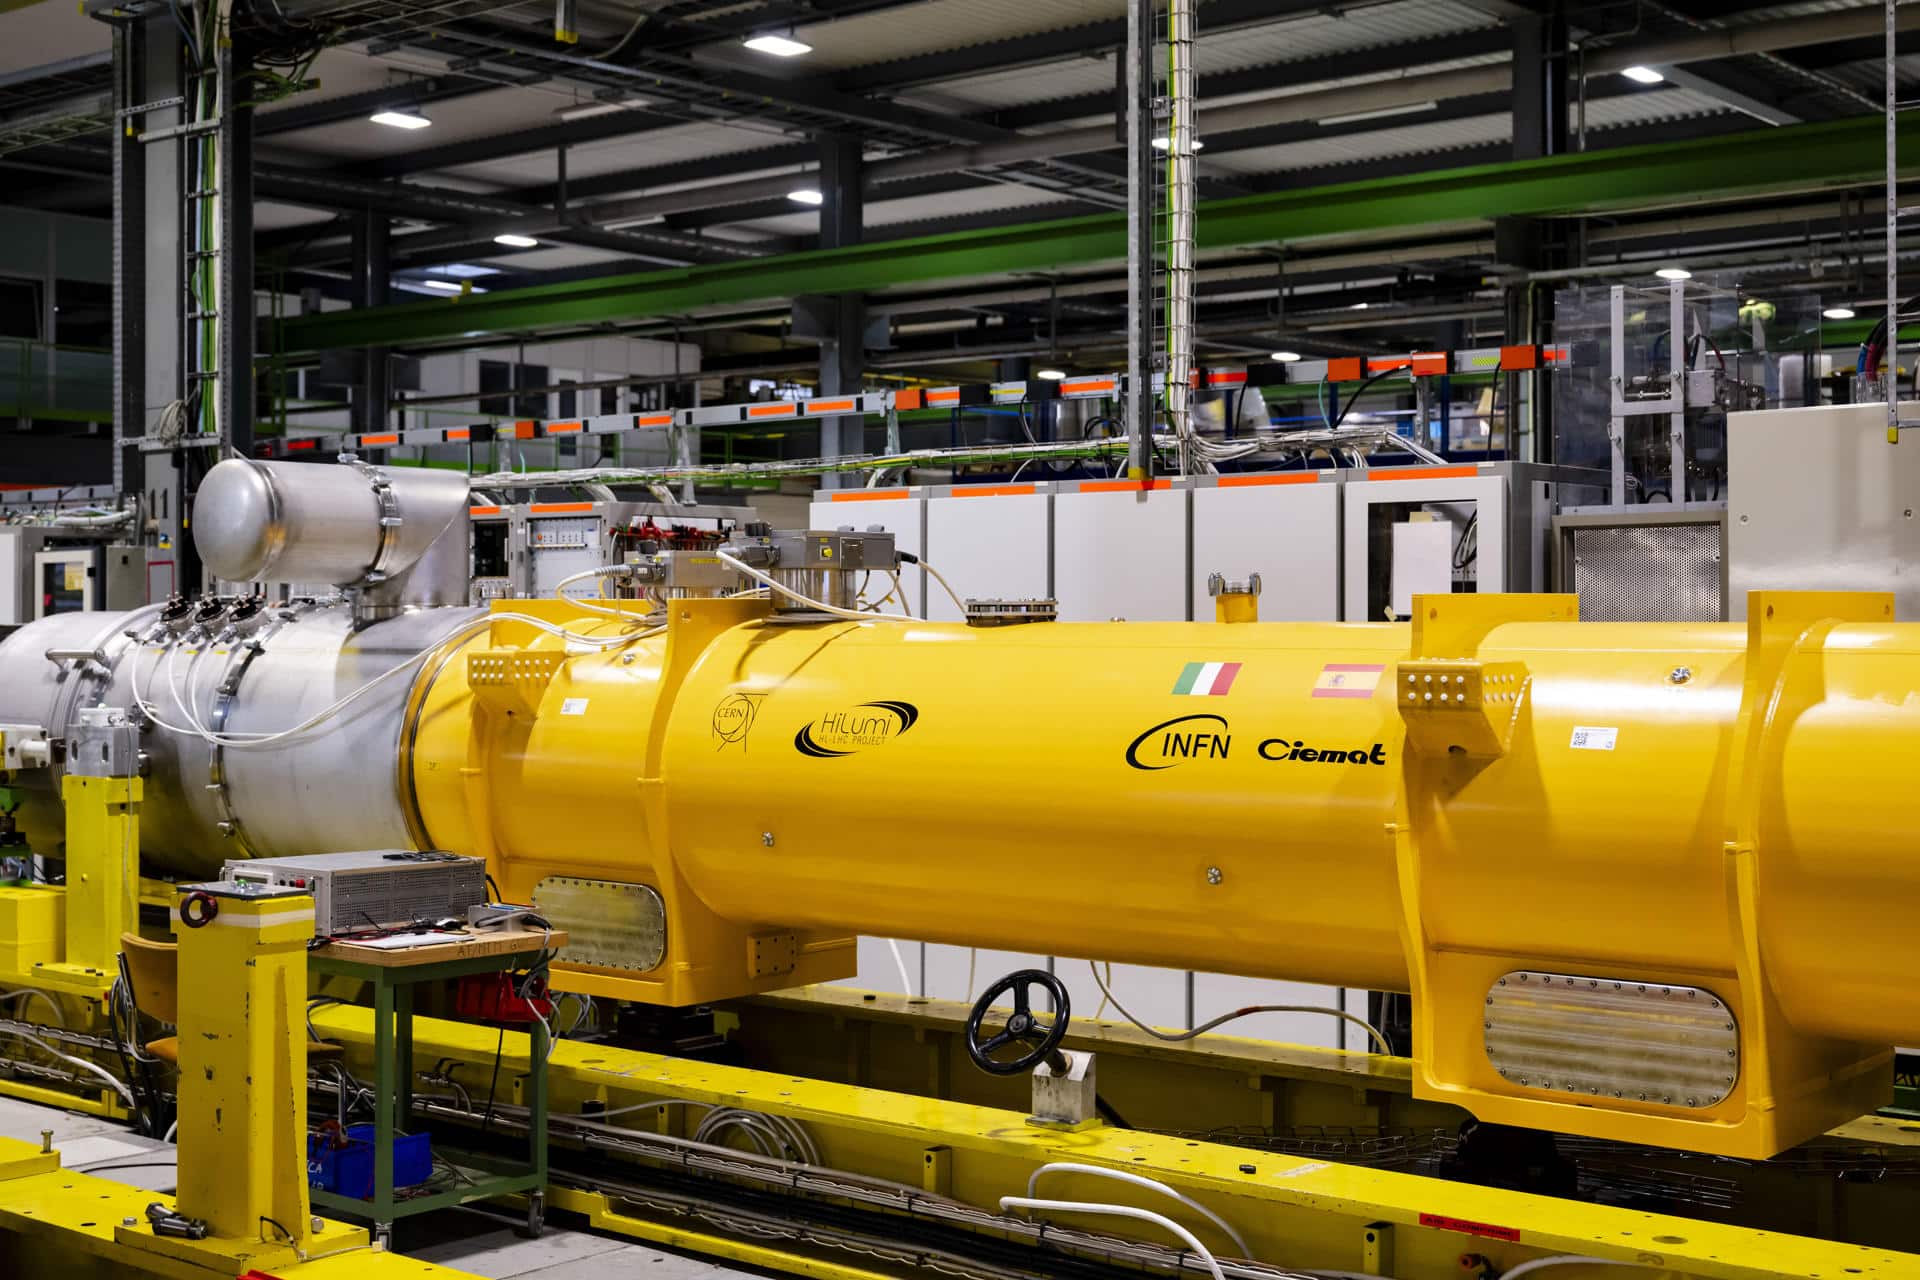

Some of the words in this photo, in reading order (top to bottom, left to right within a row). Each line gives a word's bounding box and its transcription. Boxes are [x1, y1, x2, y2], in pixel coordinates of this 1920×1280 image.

[717, 707, 744, 719] CERN
[821, 712, 893, 736] HiLumi
[852, 735, 887, 746] PROJECT
[1162, 733, 1231, 759] INFN
[1257, 738, 1386, 765] Ciemat
